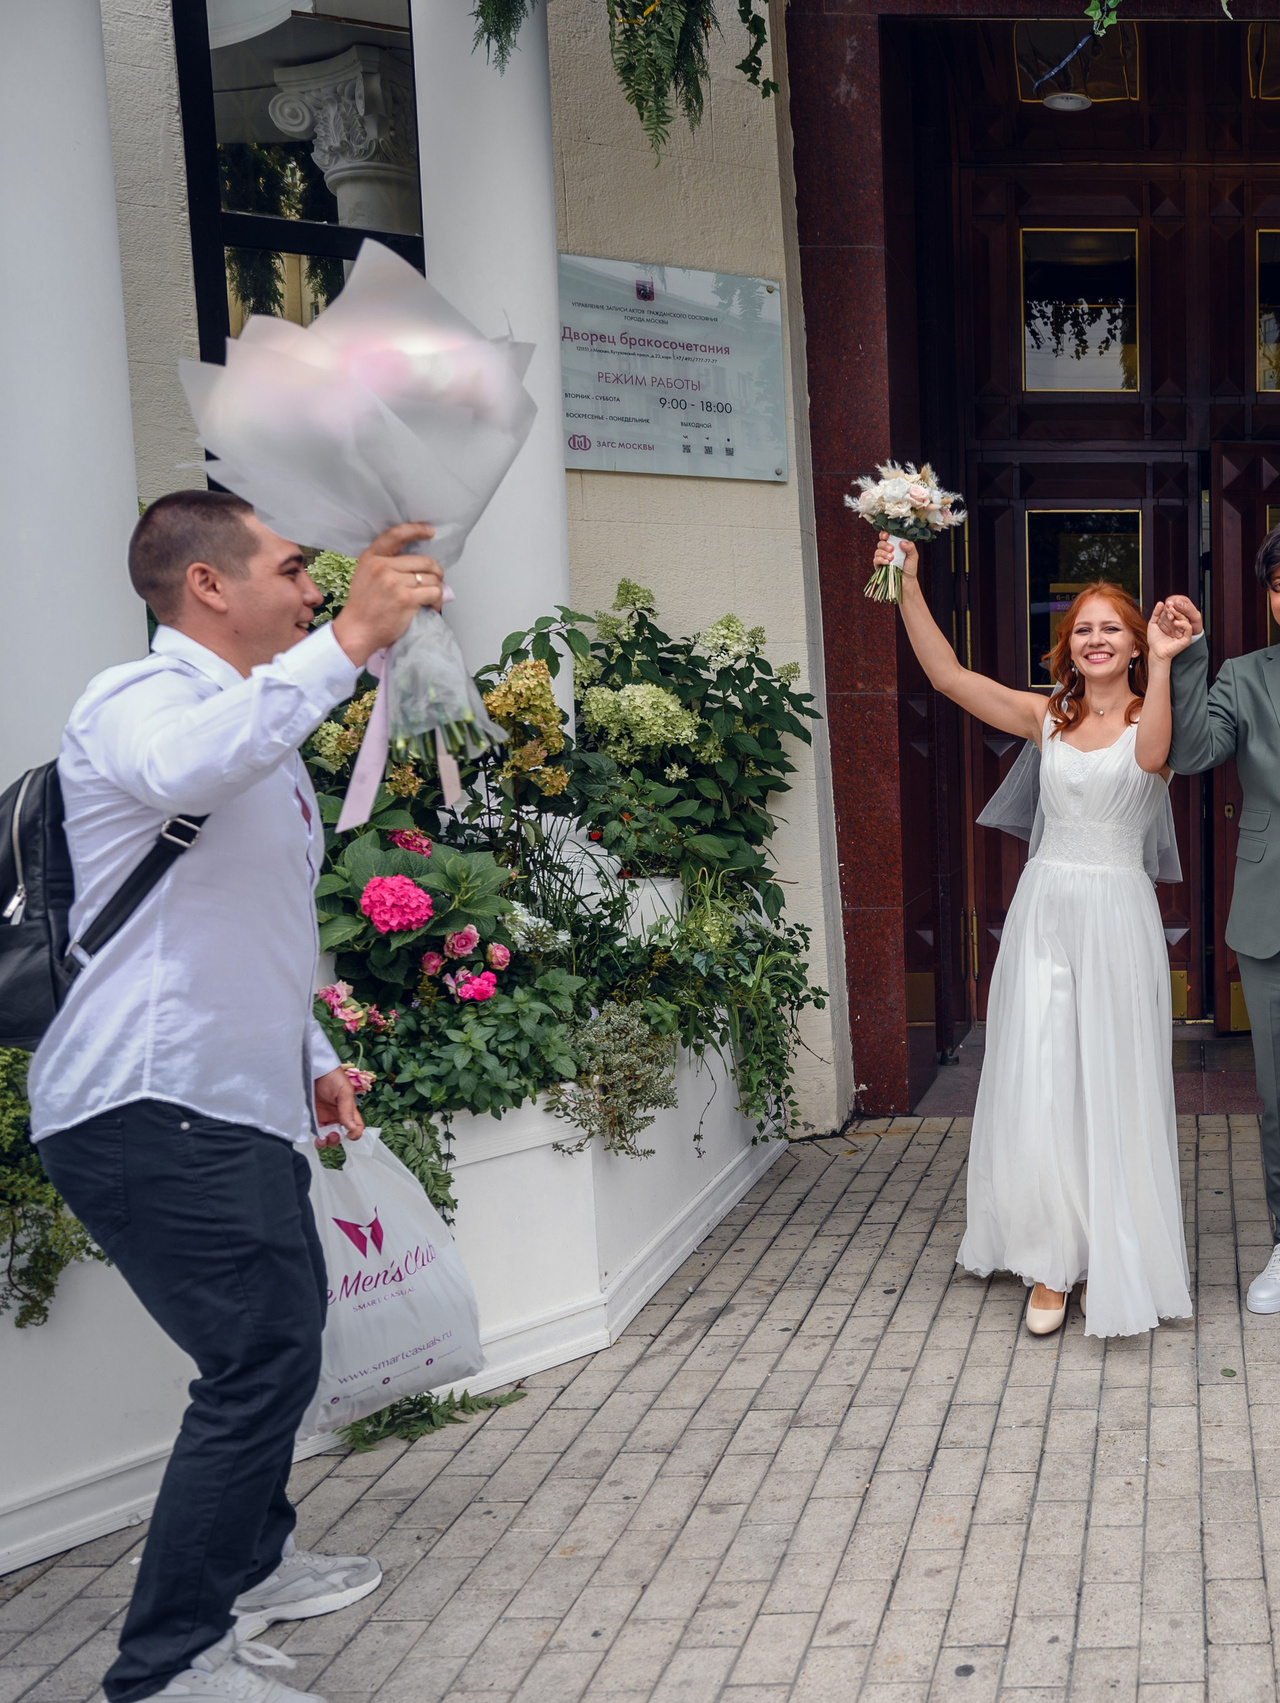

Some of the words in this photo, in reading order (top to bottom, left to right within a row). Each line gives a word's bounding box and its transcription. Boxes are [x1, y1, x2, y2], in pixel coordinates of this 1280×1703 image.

[571, 302, 605, 311] УПРАВЛЕНИЕ
[605, 305, 628, 313] ЗАПИСИ
[646, 310, 687, 319] ГРАЖДАНСКОГО
[687, 315, 719, 323] СОСТОЯНИЯ
[624, 315, 646, 323] ГОРОДА
[561, 326, 616, 345] Дворец
[619, 331, 731, 356] бракосочетания
[597, 371, 647, 387] РЕЖИМ
[651, 376, 701, 392] РАБОТЫ
[595, 395, 621, 403] СУББОТА
[659, 397, 688, 411] 9:00
[699, 400, 733, 414] 18:00
[565, 412, 605, 421] ВОСКРЕСЕНЬЕ
[608, 415, 650, 424] ПОНЕДЕЛЬНИК
[680, 421, 713, 429] ВЫХОДНОЙ
[596, 440, 617, 449] ЗАГС
[617, 441, 656, 452] МОСКВЫ
[338, 1259, 405, 1303] Men's
[404, 1236, 437, 1277] Club
[352, 1298, 381, 1313] SMART
[337, 1329, 453, 1385] www.smartcasuals.ru
